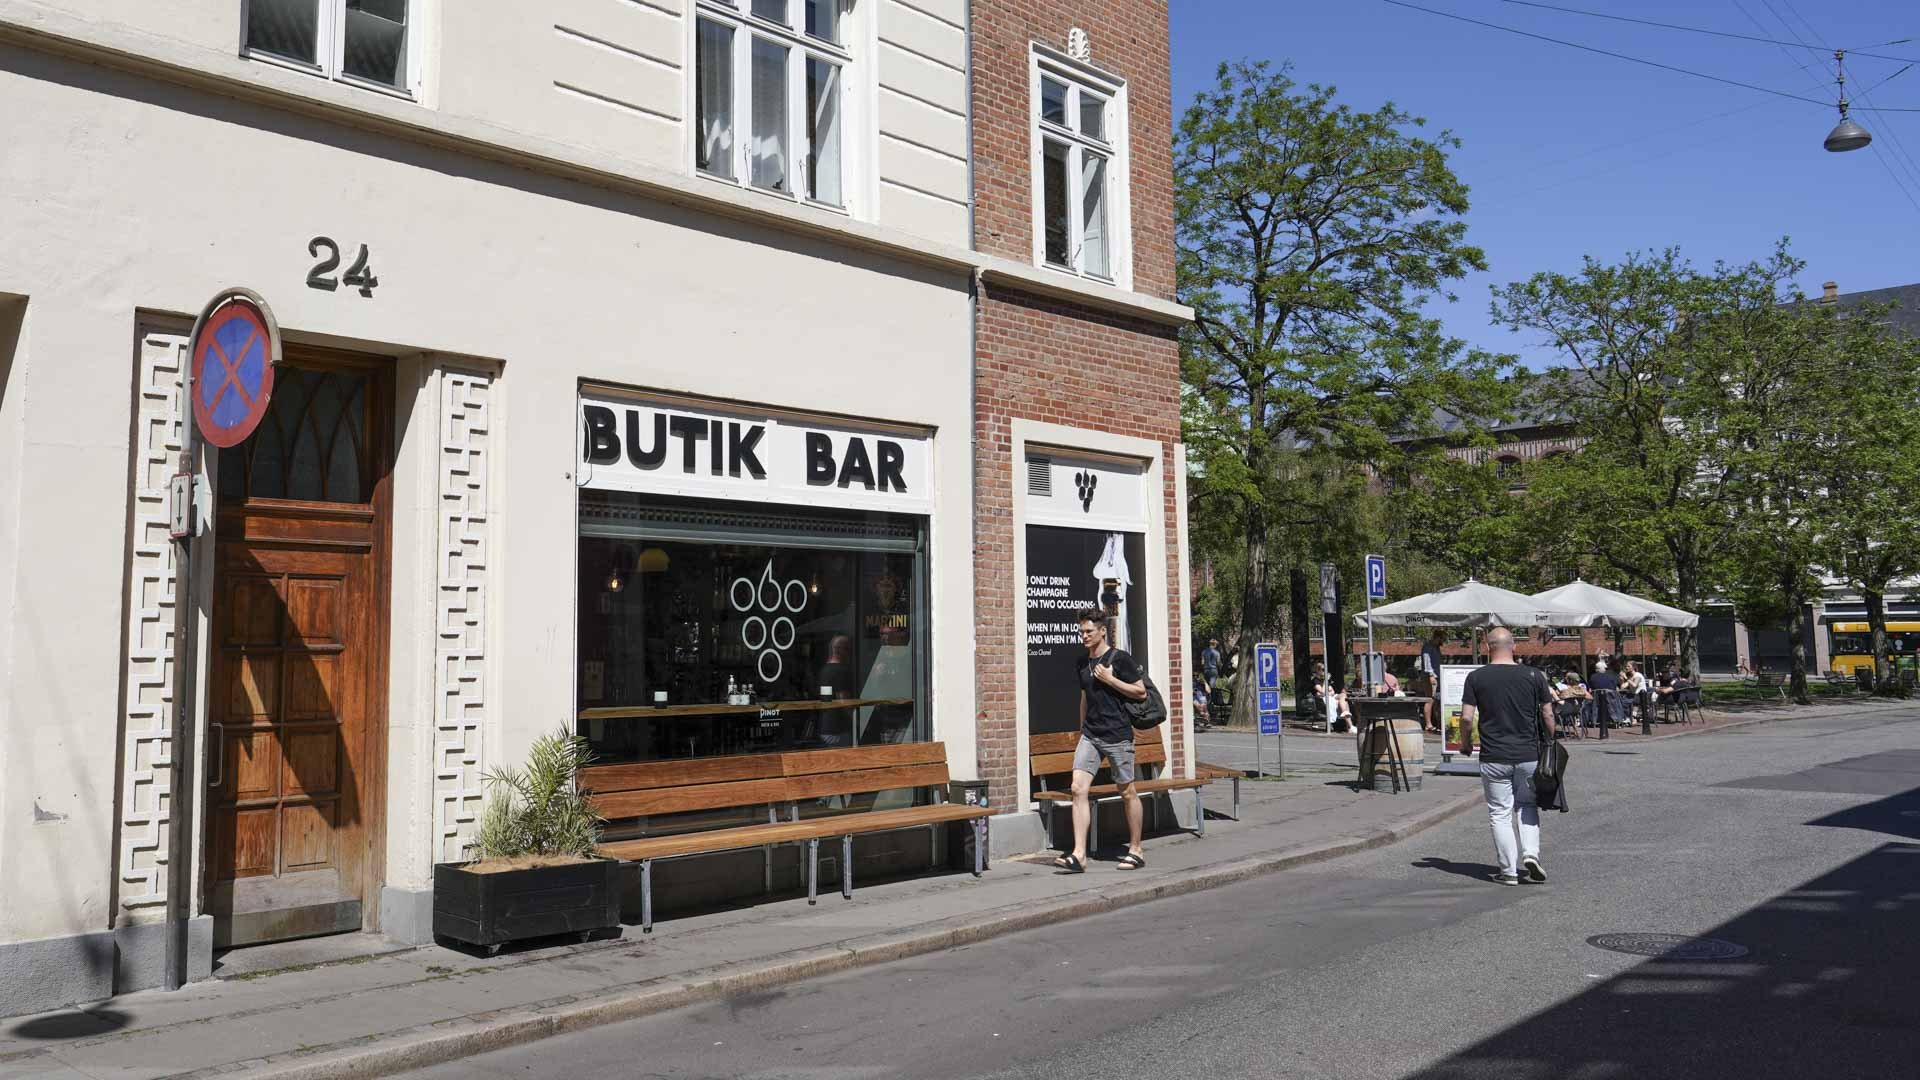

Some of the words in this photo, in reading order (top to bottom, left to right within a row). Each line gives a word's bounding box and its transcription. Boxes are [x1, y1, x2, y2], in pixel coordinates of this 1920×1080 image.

[306, 236, 378, 298] 24
[584, 405, 767, 480] BUTIK
[806, 431, 908, 493] BAR
[1030, 576, 1048, 585] ONLY
[1050, 577, 1070, 586] DRINK
[1372, 564, 1380, 592] P
[1027, 588, 1068, 597] CHAMPAGNE
[1027, 599, 1038, 608] ON
[1040, 600, 1055, 608] TWO
[1028, 624, 1048, 632] WHEN
[1050, 624, 1060, 632] I'M
[1062, 624, 1069, 632] IN
[1028, 635, 1042, 643] AND
[1044, 635, 1064, 644] WHEN
[1066, 635, 1076, 644] I'M
[1262, 653, 1273, 683] P
[760, 708, 780, 718] PINOT
